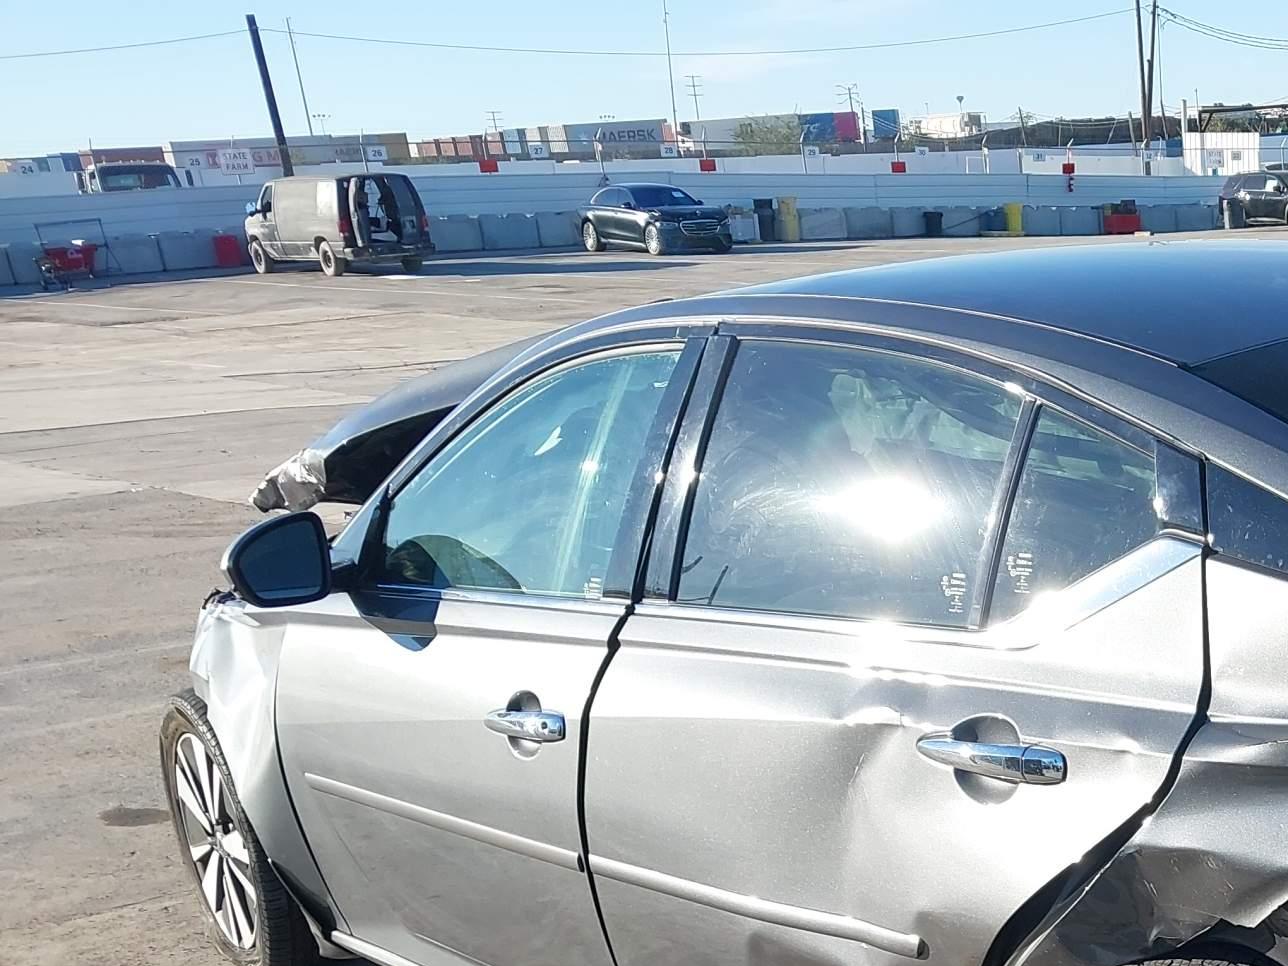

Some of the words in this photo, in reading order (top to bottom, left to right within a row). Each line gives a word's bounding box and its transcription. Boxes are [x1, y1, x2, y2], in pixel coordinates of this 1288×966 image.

[371, 149, 383, 157] 26
[664, 146, 674, 154] 28
[222, 151, 248, 161] STATE
[189, 158, 201, 167] 25
[226, 162, 249, 171] FARM
[21, 165, 34, 174] 24
